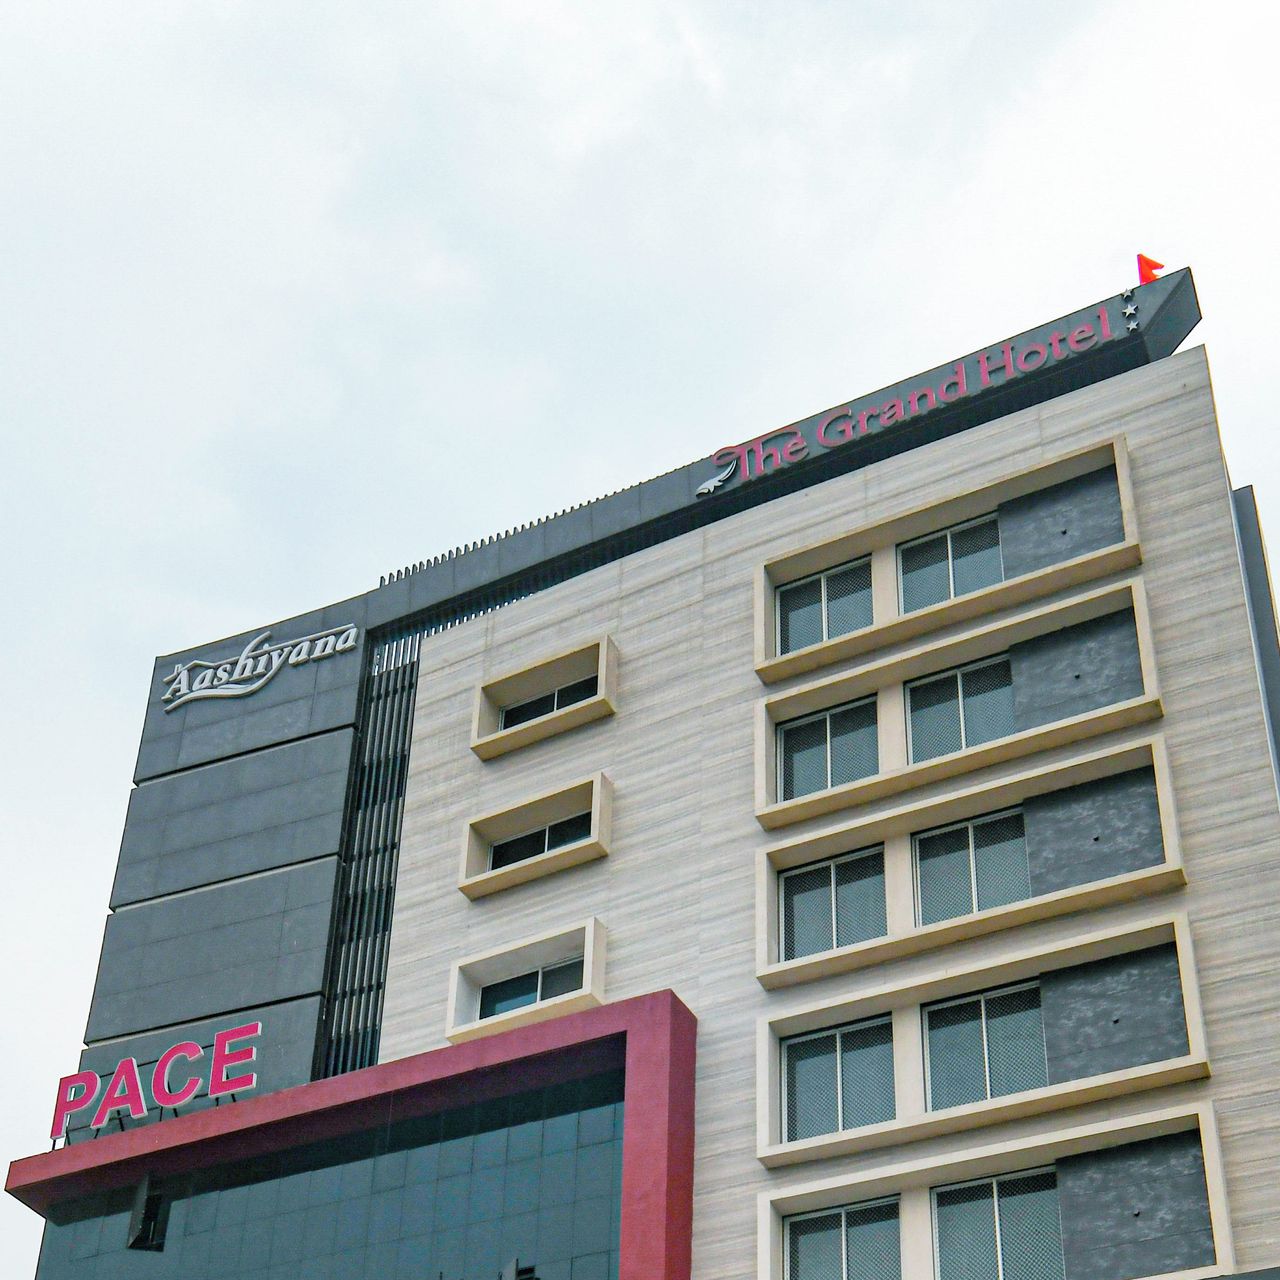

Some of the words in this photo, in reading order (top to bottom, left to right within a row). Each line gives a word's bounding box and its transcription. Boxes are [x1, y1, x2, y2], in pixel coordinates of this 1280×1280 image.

[712, 427, 808, 482] The
[817, 362, 967, 448] Grand
[978, 307, 1116, 388] Hotel
[161, 624, 358, 712] Aashiyana
[50, 1021, 262, 1140] PACE
